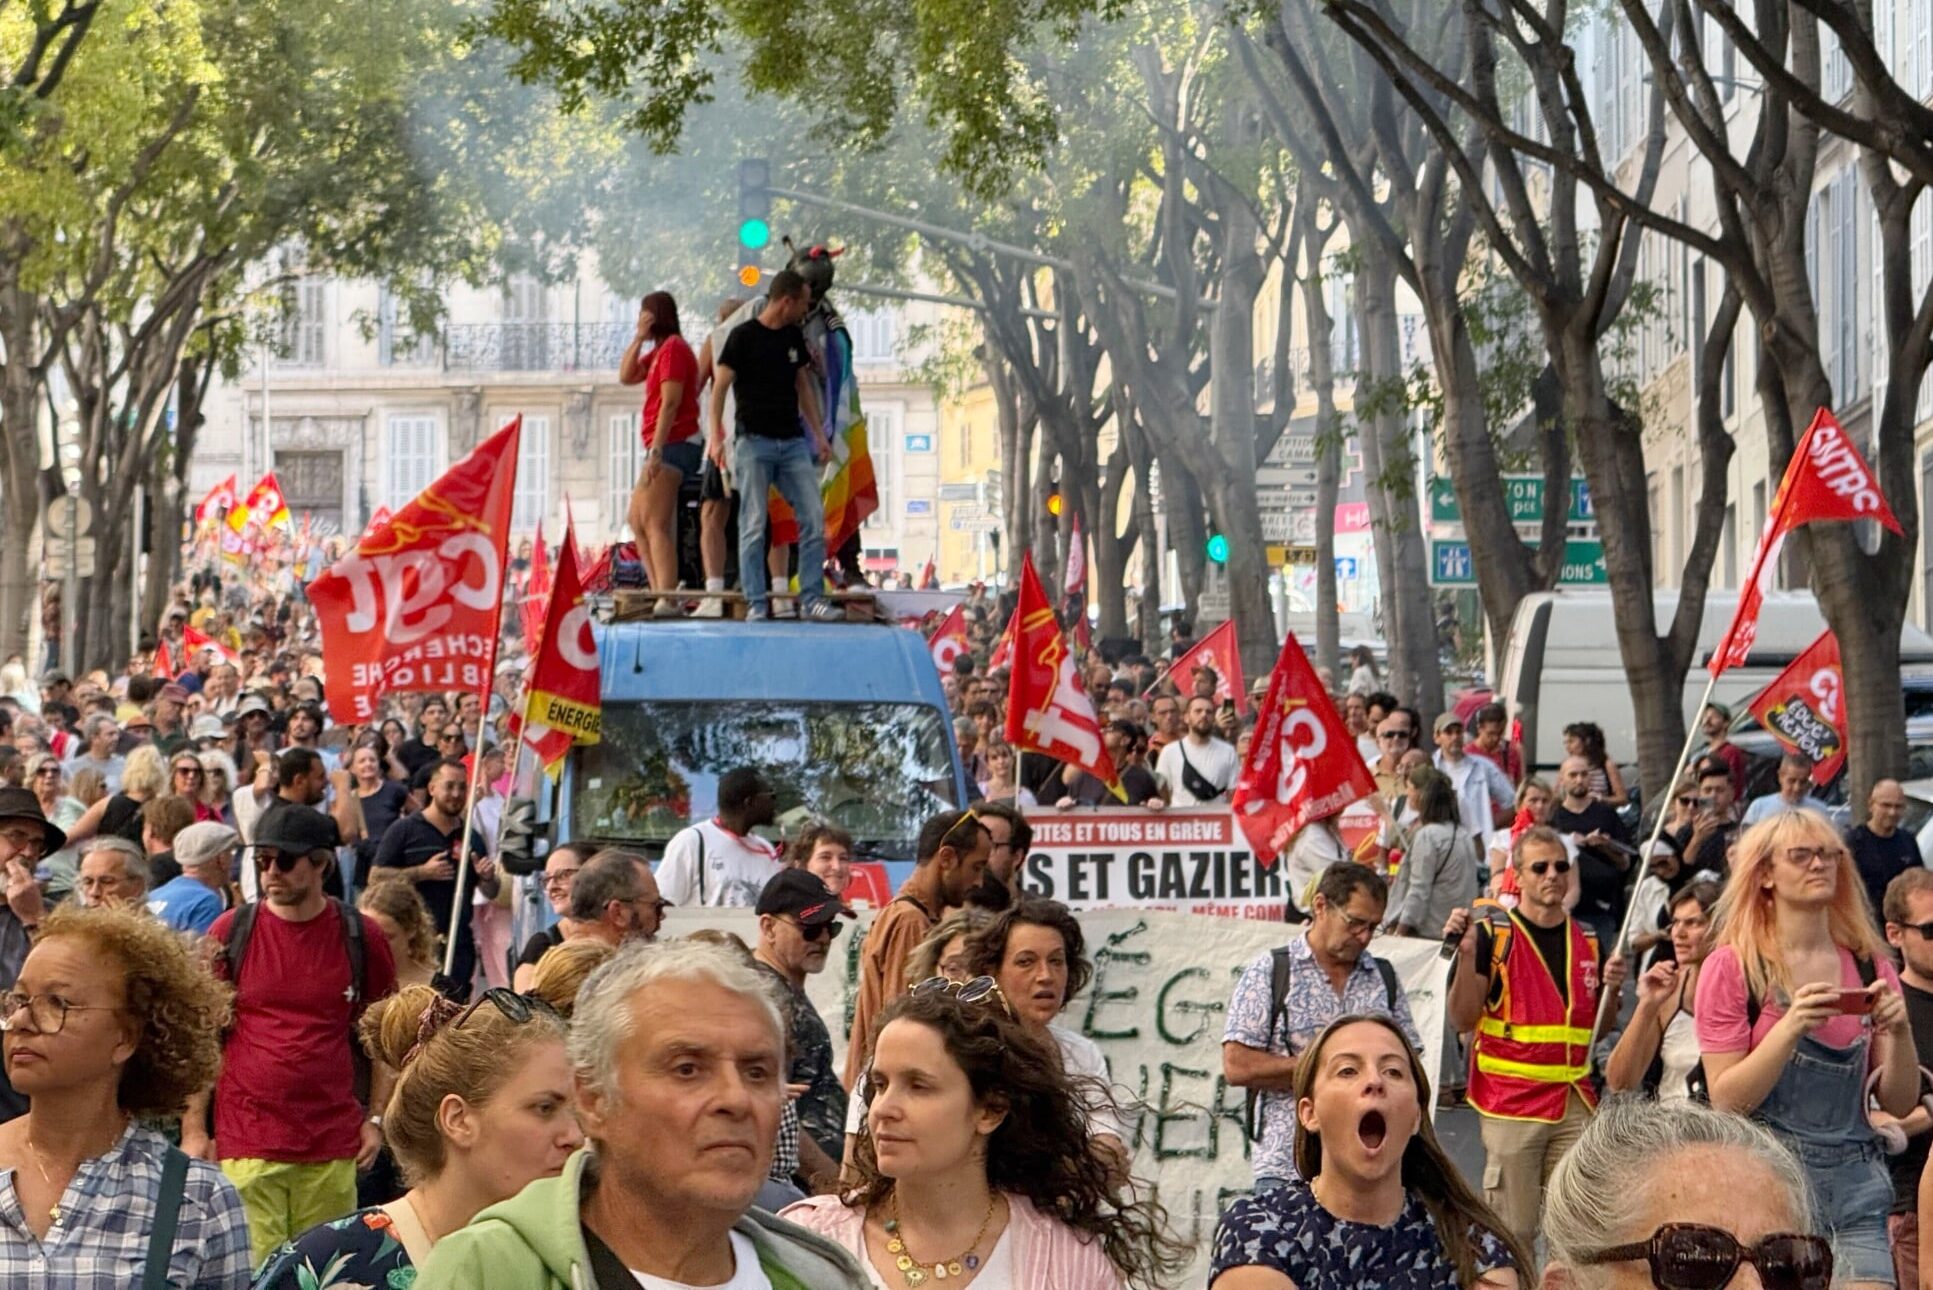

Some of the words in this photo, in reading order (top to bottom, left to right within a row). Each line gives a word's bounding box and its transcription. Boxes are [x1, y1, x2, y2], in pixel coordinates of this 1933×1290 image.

[1279, 449, 1314, 459] CAMA
[1560, 564, 1594, 580] IONS
[1031, 823, 1072, 842] UTES
[1075, 823, 1094, 842] ET
[1097, 822, 1142, 841] TOUS
[1145, 821, 1166, 840] EN
[1168, 819, 1223, 840] GRÈVE
[1067, 853, 1115, 900] ET
[1127, 851, 1289, 901] GAZIER
